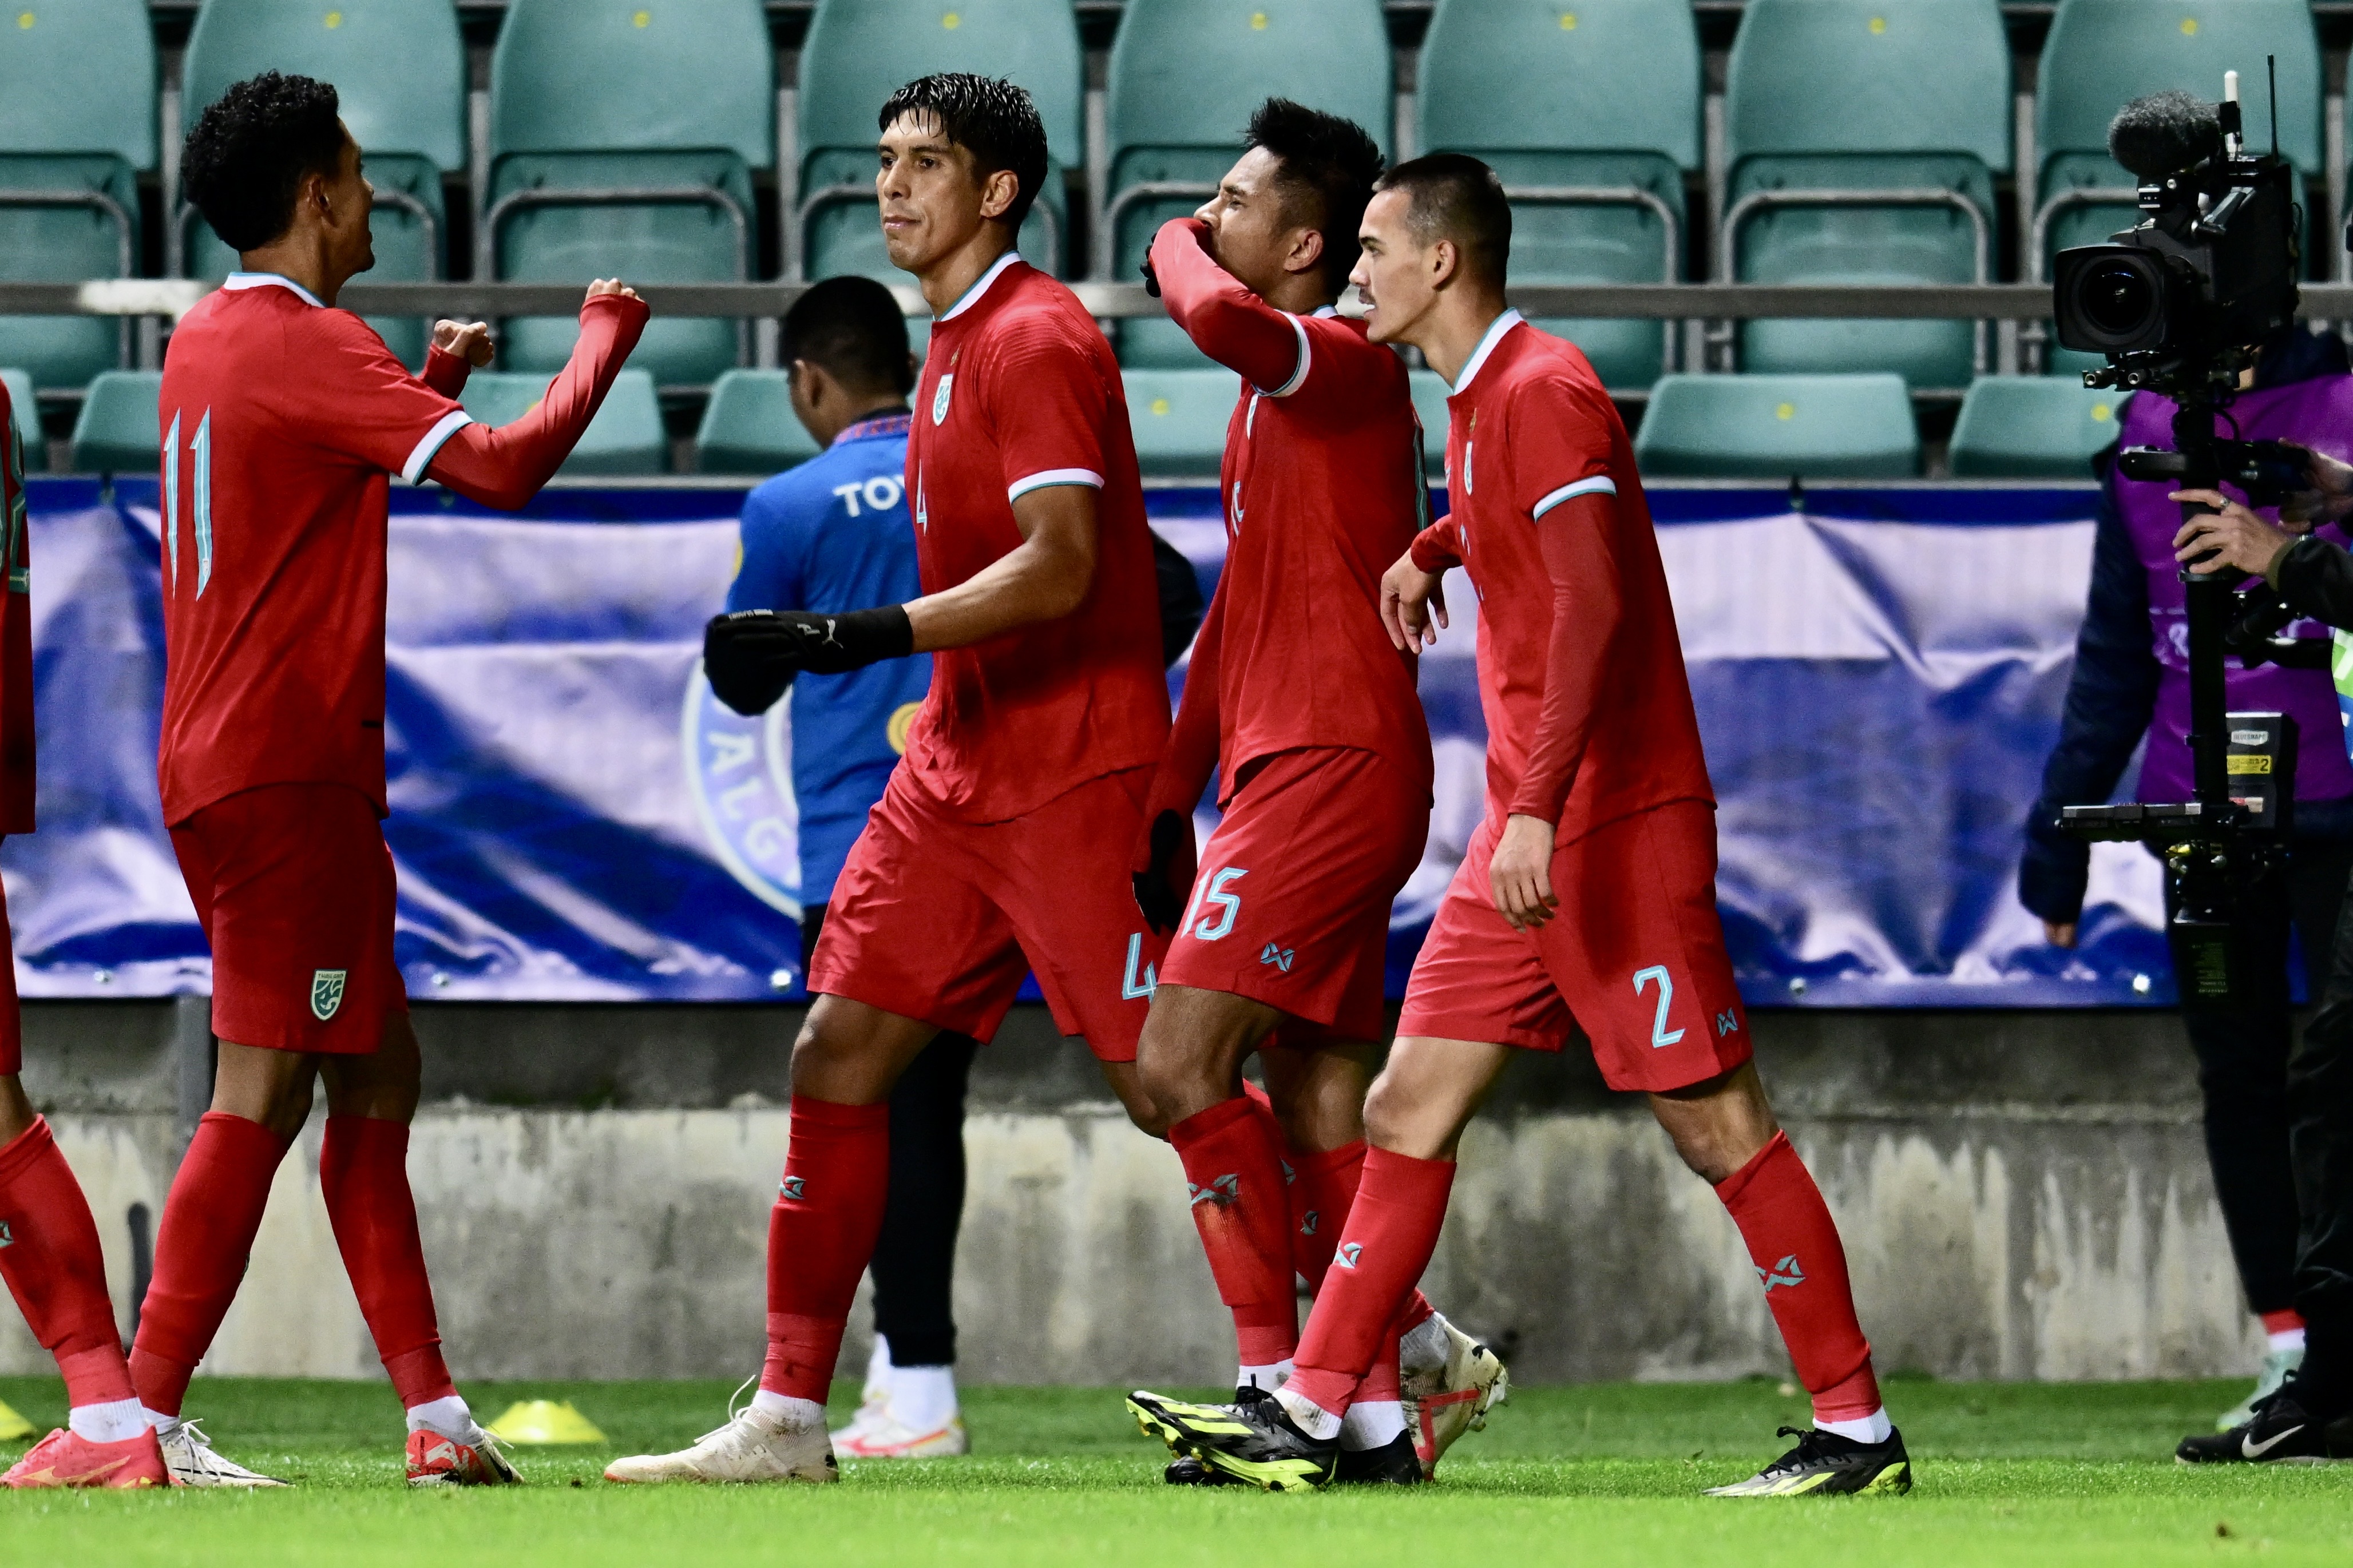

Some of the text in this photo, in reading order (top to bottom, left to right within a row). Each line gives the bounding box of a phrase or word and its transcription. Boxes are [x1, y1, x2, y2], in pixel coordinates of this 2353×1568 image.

[163, 405, 213, 602] 11
[833, 475, 905, 518] TO
[916, 459, 928, 535] 4
[2260, 758, 2269, 772] 2
[1181, 867, 1249, 941] 15
[1122, 932, 1158, 1004] 4
[1632, 964, 1686, 1049] 2
